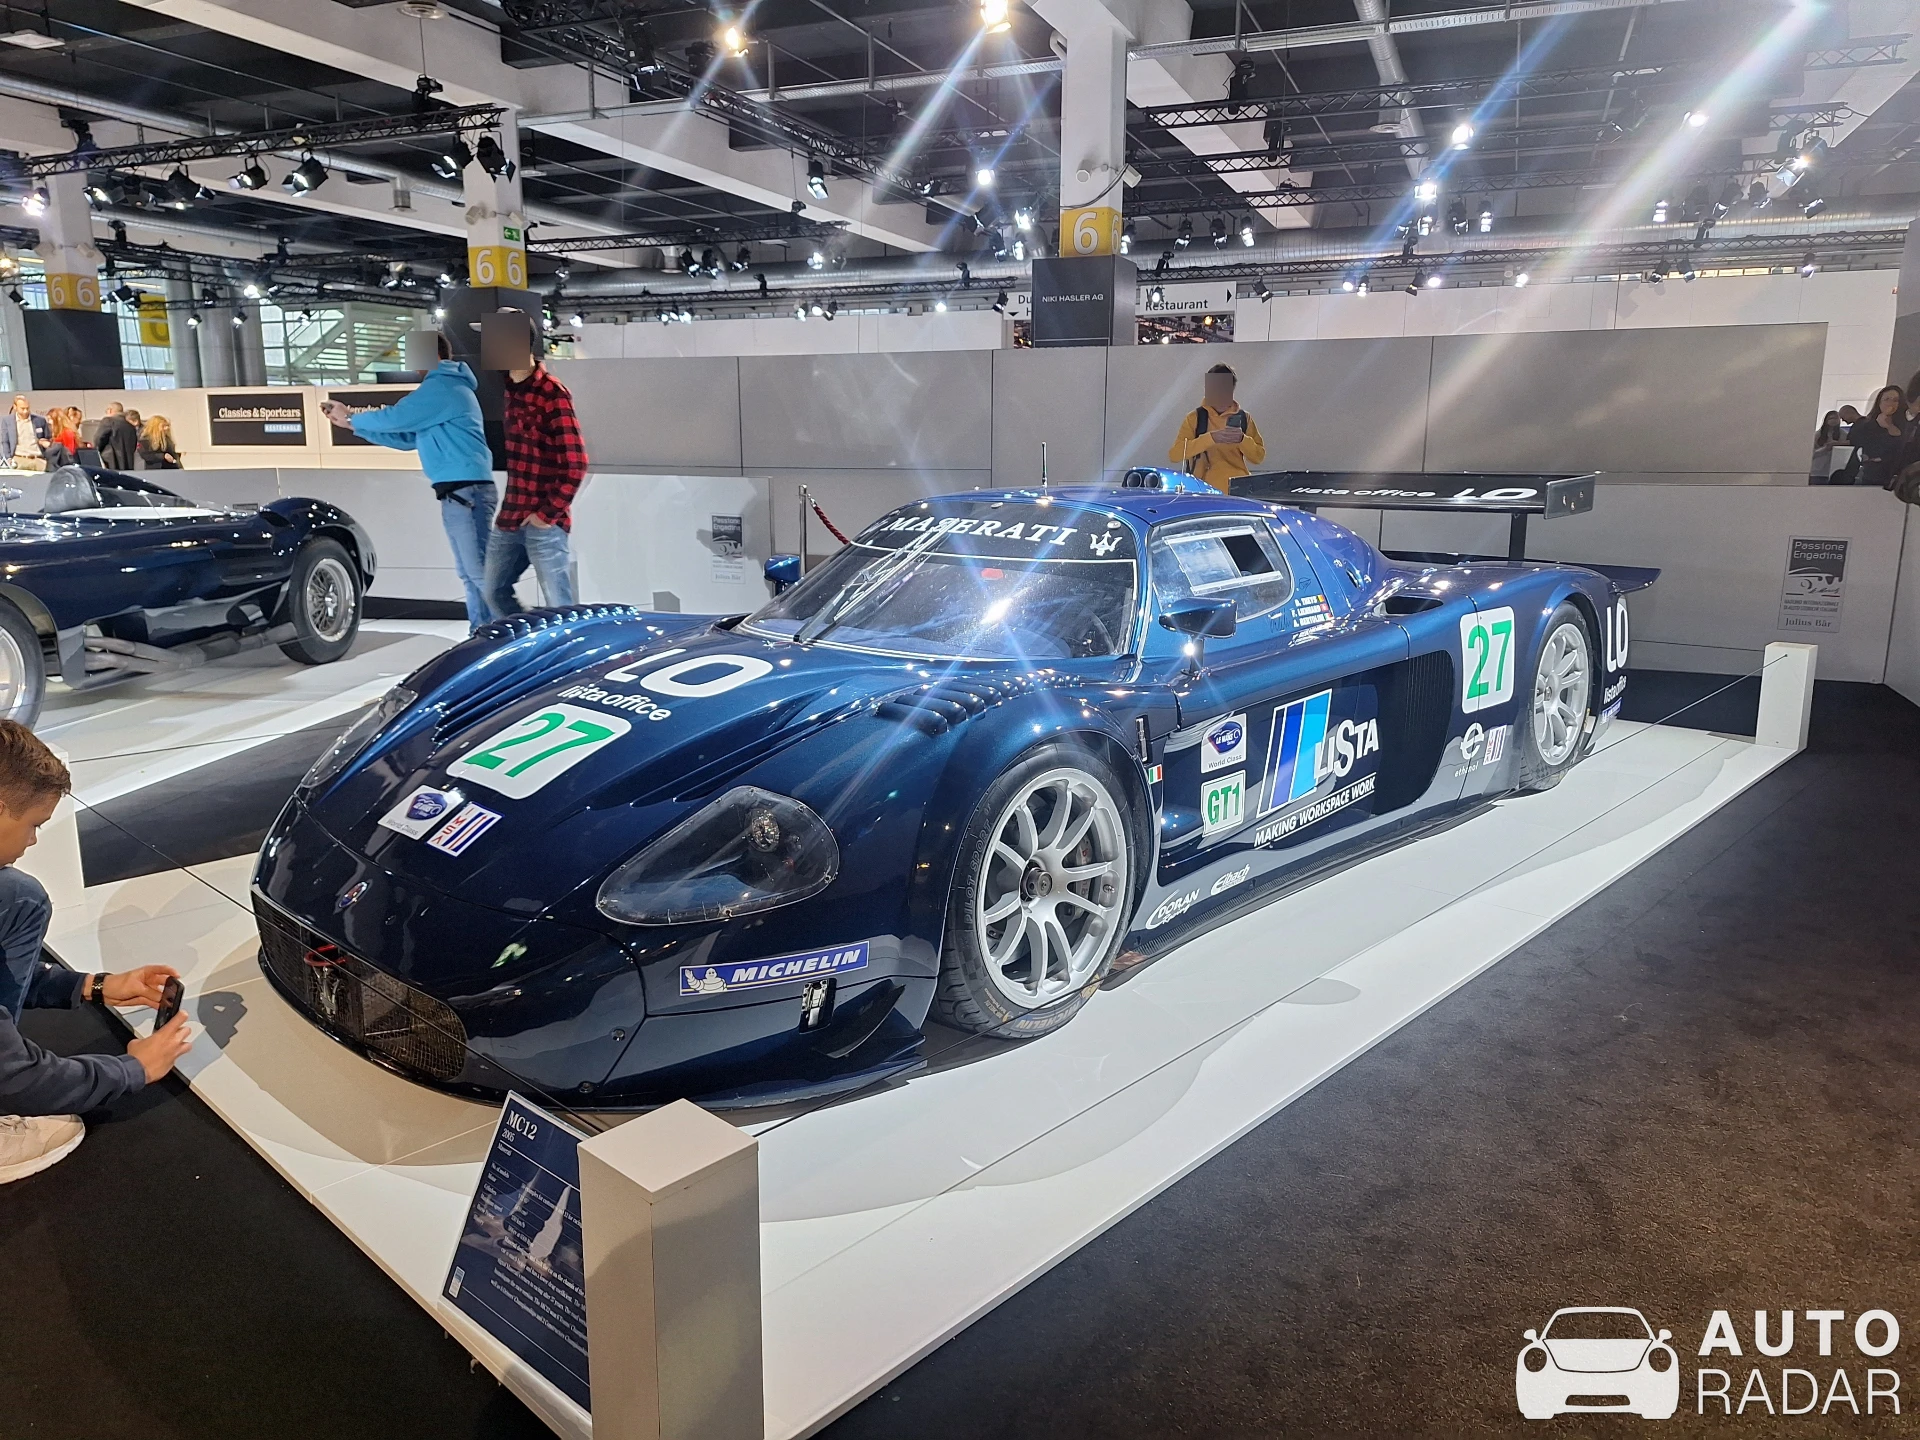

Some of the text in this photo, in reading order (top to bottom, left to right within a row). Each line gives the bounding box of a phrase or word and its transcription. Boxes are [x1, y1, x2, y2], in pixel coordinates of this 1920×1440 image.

[1073, 211, 1099, 255] 6
[1111, 214, 1120, 255] 6
[475, 249, 496, 285] 6
[507, 251, 523, 286] 6
[52, 275, 65, 307] 6
[76, 277, 95, 308] 6
[1042, 293, 1104, 303] NIKI HASLER AG
[1145, 299, 1209, 311] Restaurant
[218, 407, 301, 421] Classics & Sportcars
[1353, 489, 1436, 497] office
[1450, 487, 1538, 500] LO
[880, 516, 1078, 546] MASERATI
[1794, 541, 1845, 551] Passione
[1793, 551, 1844, 560] Engadina
[1606, 594, 1629, 673] LO
[1785, 618, 1812, 627] Julius
[604, 648, 774, 698] LO
[1466, 619, 1512, 700] 27
[601, 694, 672, 721] office
[463, 711, 617, 779] 27
[1208, 754, 1242, 769] World Class
[1207, 781, 1241, 826] GT1
[1254, 776, 1376, 848] MAKING WORKSPACE WORK
[401, 821, 419, 836] Class
[1157, 888, 1201, 919] DORAN
[731, 949, 861, 983] MICHELIN
[502, 1128, 515, 1142] 2005
[506, 1109, 538, 1140] MC12
